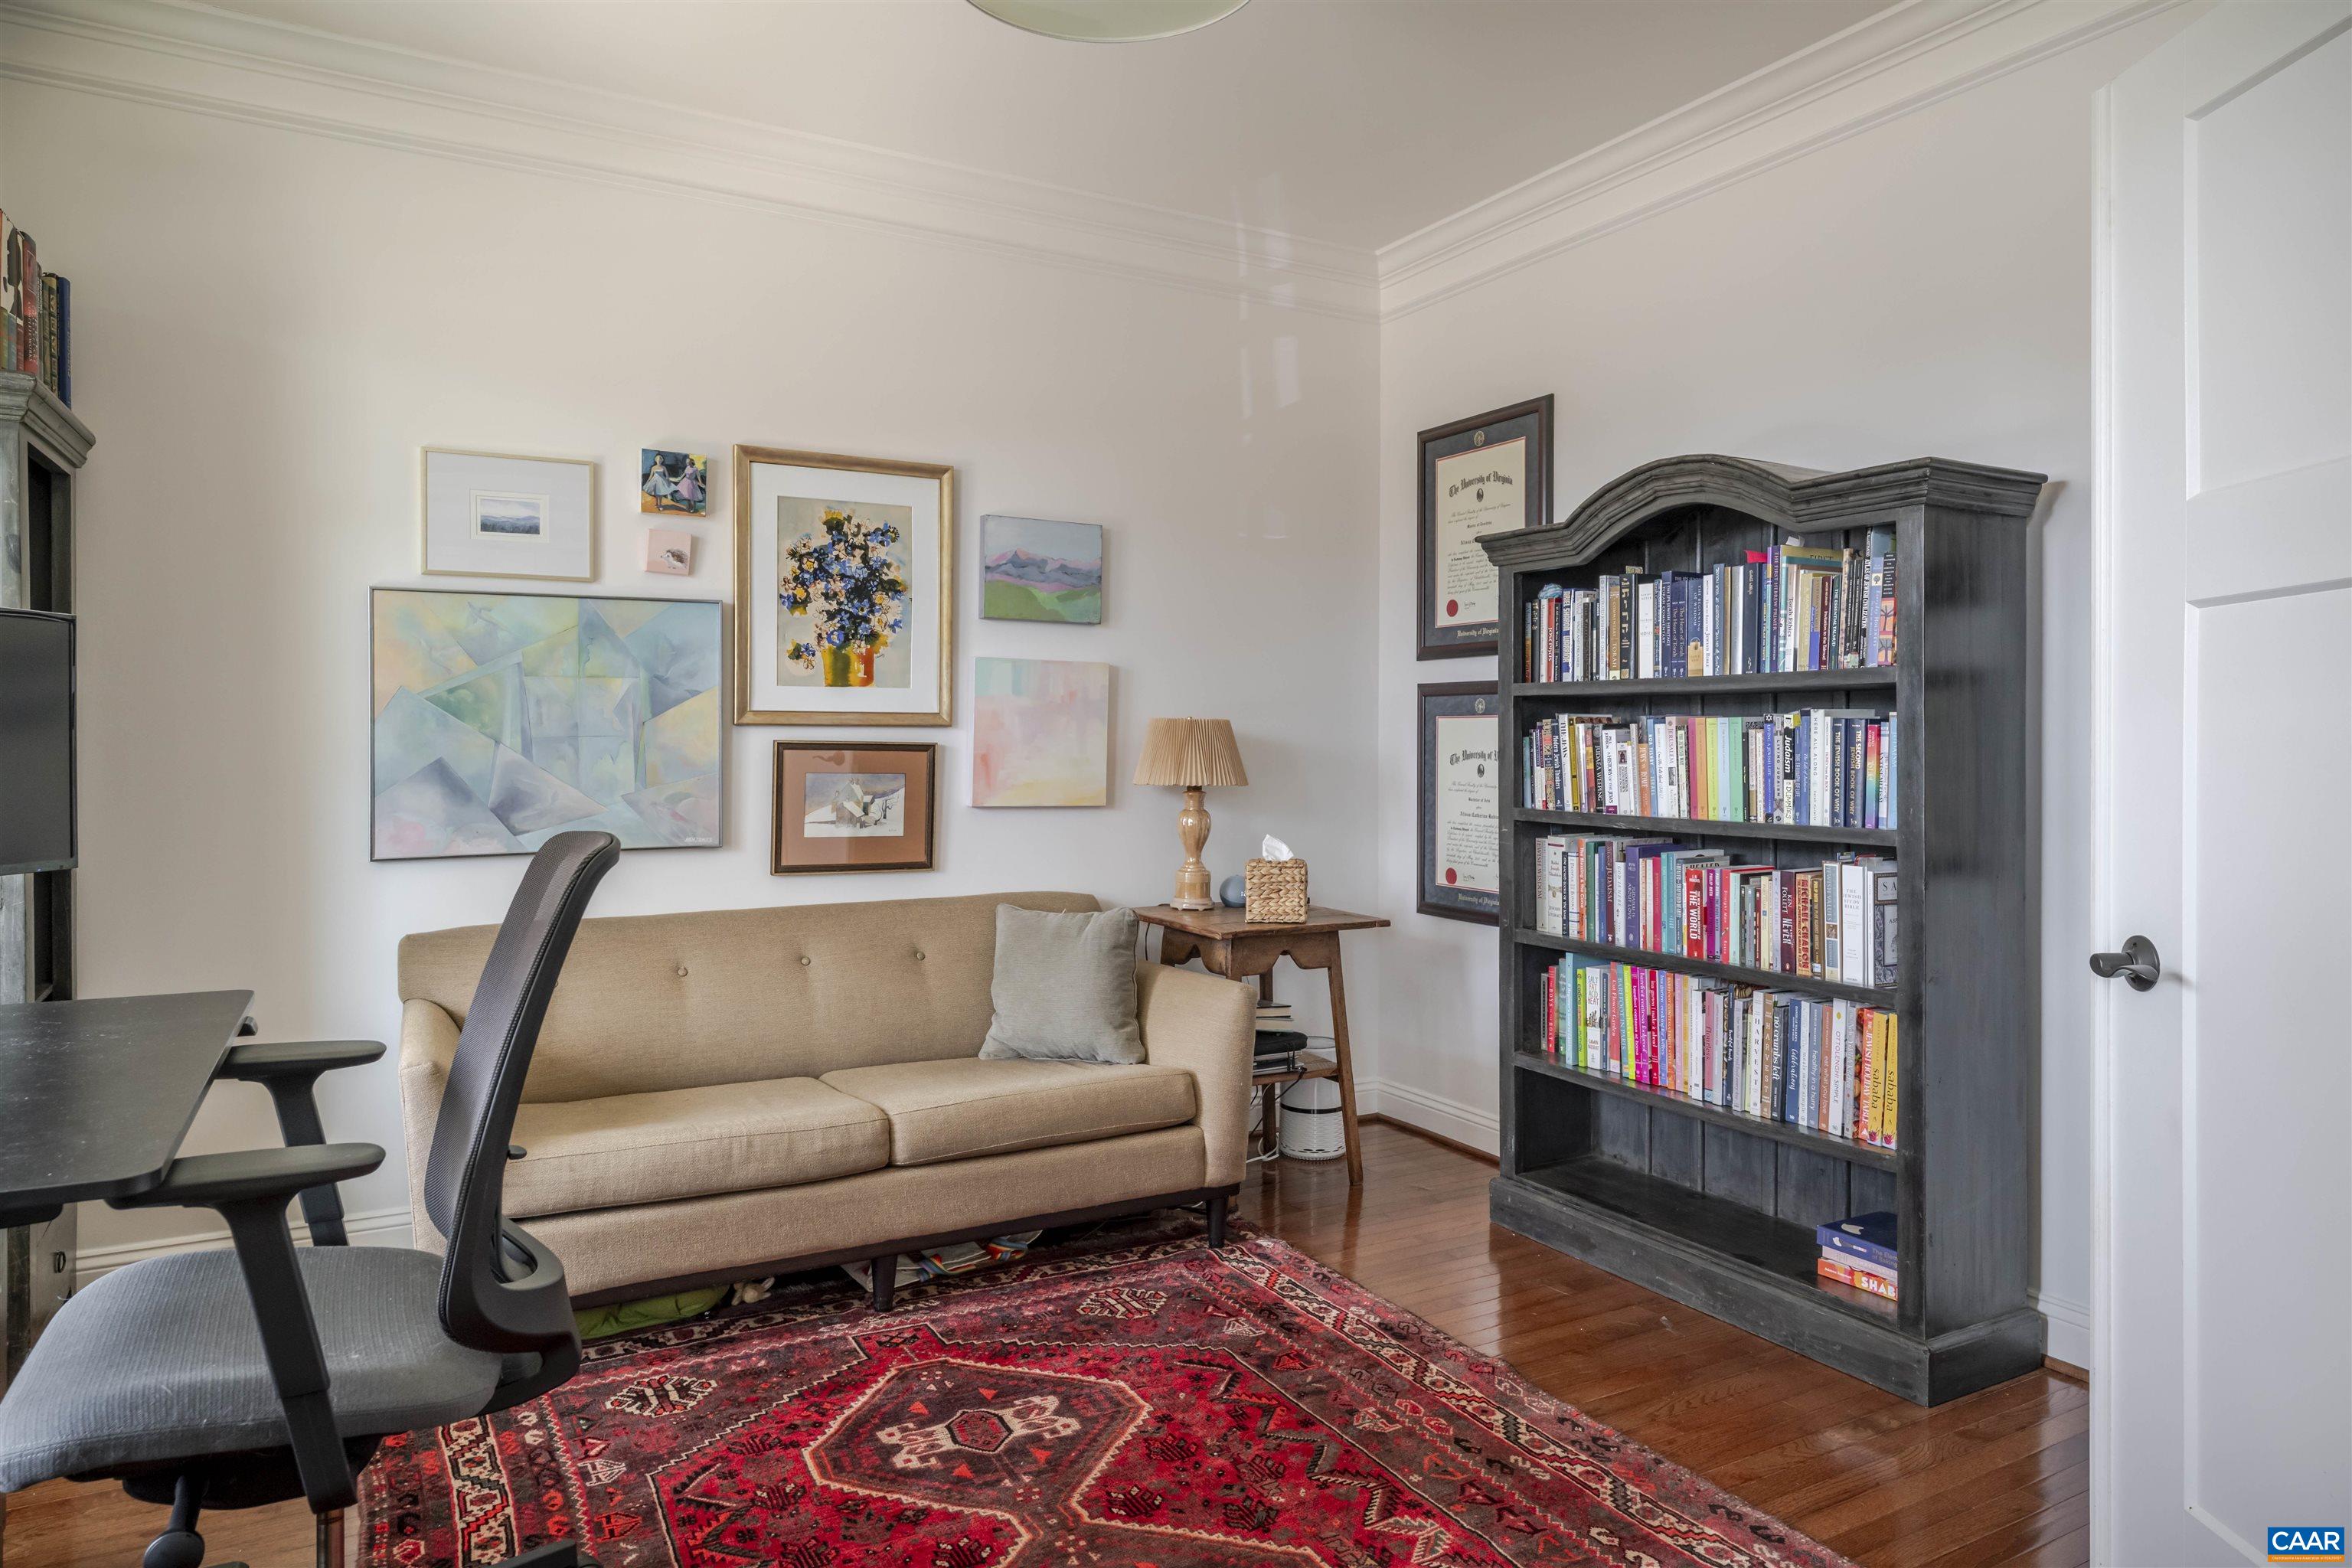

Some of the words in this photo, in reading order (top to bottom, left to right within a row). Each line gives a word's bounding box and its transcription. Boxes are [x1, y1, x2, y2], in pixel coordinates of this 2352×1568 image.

[1449, 485, 1459, 497] The
[1461, 473, 1485, 491] University
[1486, 473, 1491, 482] of
[1493, 471, 1513, 485] Virginia
[1457, 629, 1477, 638] University
[1482, 627, 1499, 636] Virginia
[1449, 753, 1460, 765] The
[1462, 750, 1486, 761] University
[1488, 751, 1492, 760] of
[1834, 789, 1840, 798] OF
[1850, 791, 1855, 799] OF
[1458, 893, 1478, 903] University
[1782, 919, 1792, 944] NEVER
[1588, 998, 1599, 1006] HEAT
[1620, 1020, 1625, 1029] IN
[1774, 1016, 1779, 1027] no
[1864, 1063, 1872, 1096] HOLIDAY
[1871, 1068, 1881, 1109] sababa
[1886, 1070, 1896, 1112] sababa
[1861, 1276, 1898, 1299] SHAB
